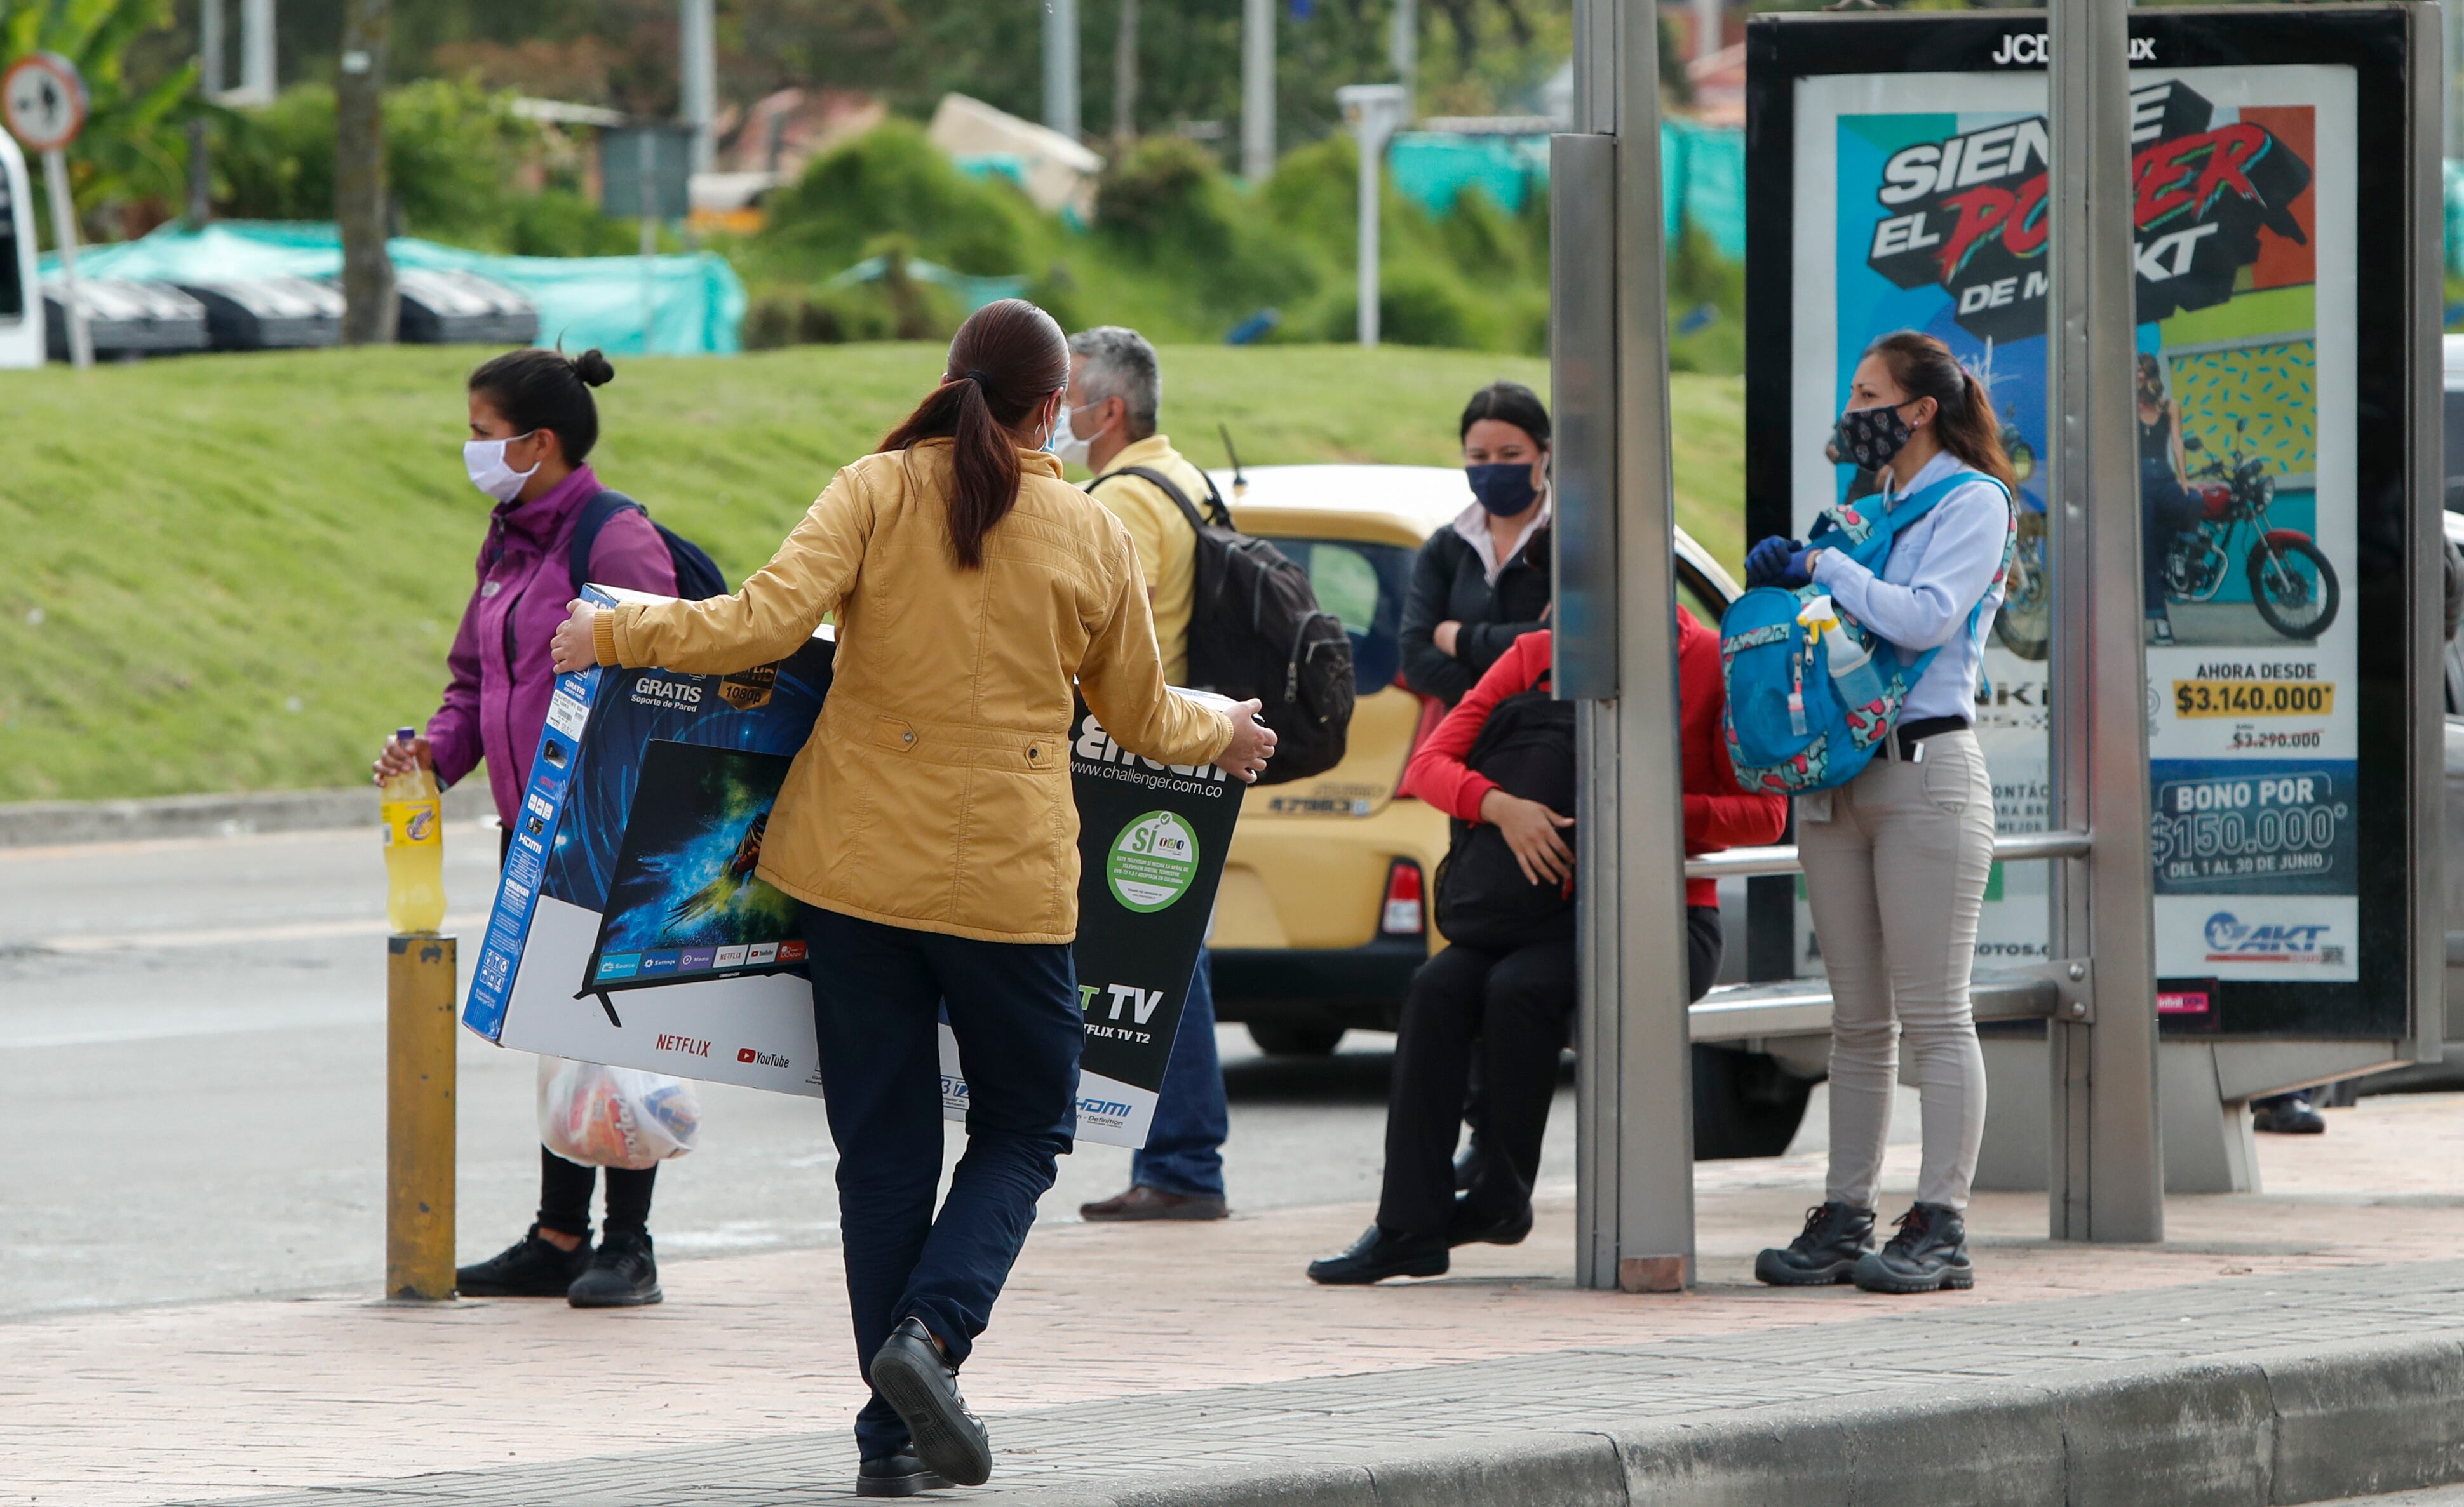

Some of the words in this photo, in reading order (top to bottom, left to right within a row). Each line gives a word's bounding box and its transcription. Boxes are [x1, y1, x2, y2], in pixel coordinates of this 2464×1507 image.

[1879, 85, 2171, 204] SIENE
[1871, 211, 1941, 258] EL
[1935, 121, 2267, 284] POER
[1958, 277, 2018, 316] DE
[2023, 270, 2048, 299] M
[2134, 222, 2218, 282] KT
[2197, 664, 2255, 679] AHORA
[2261, 664, 2317, 679] DESDE
[565, 680, 586, 696] GRATIS
[636, 677, 702, 703] GRATIS
[727, 685, 762, 704] 1080p
[631, 693, 661, 706] Soporte
[663, 700, 673, 709] de
[674, 702, 697, 713] Pared
[2233, 732, 2320, 749] $3.290.000
[1993, 780, 2048, 798] ONTÁC
[2176, 782, 2251, 812] BONO
[2259, 777, 2315, 806] POR
[518, 833, 542, 854] HDMI
[1132, 824, 1161, 853] SÍ
[2170, 861, 2198, 878] DEL
[2202, 861, 2210, 874] 1
[2212, 859, 2232, 874] AL
[2237, 857, 2253, 873] 30
[2258, 855, 2275, 871] DE
[2280, 852, 2322, 869] JUNIO
[2237, 925, 2331, 951] AKT
[719, 952, 742, 961] NETFLIX
[1107, 984, 1164, 1024] TV
[1084, 1023, 1115, 1038] TFLIX
[1117, 1029, 1133, 1041] TV
[1135, 1031, 1151, 1044] T2
[656, 1033, 711, 1058] NETFLIX
[756, 1052, 790, 1068] YouTube
[1075, 1097, 1133, 1118] HDMI
[1088, 1115, 1123, 1126] Definition
